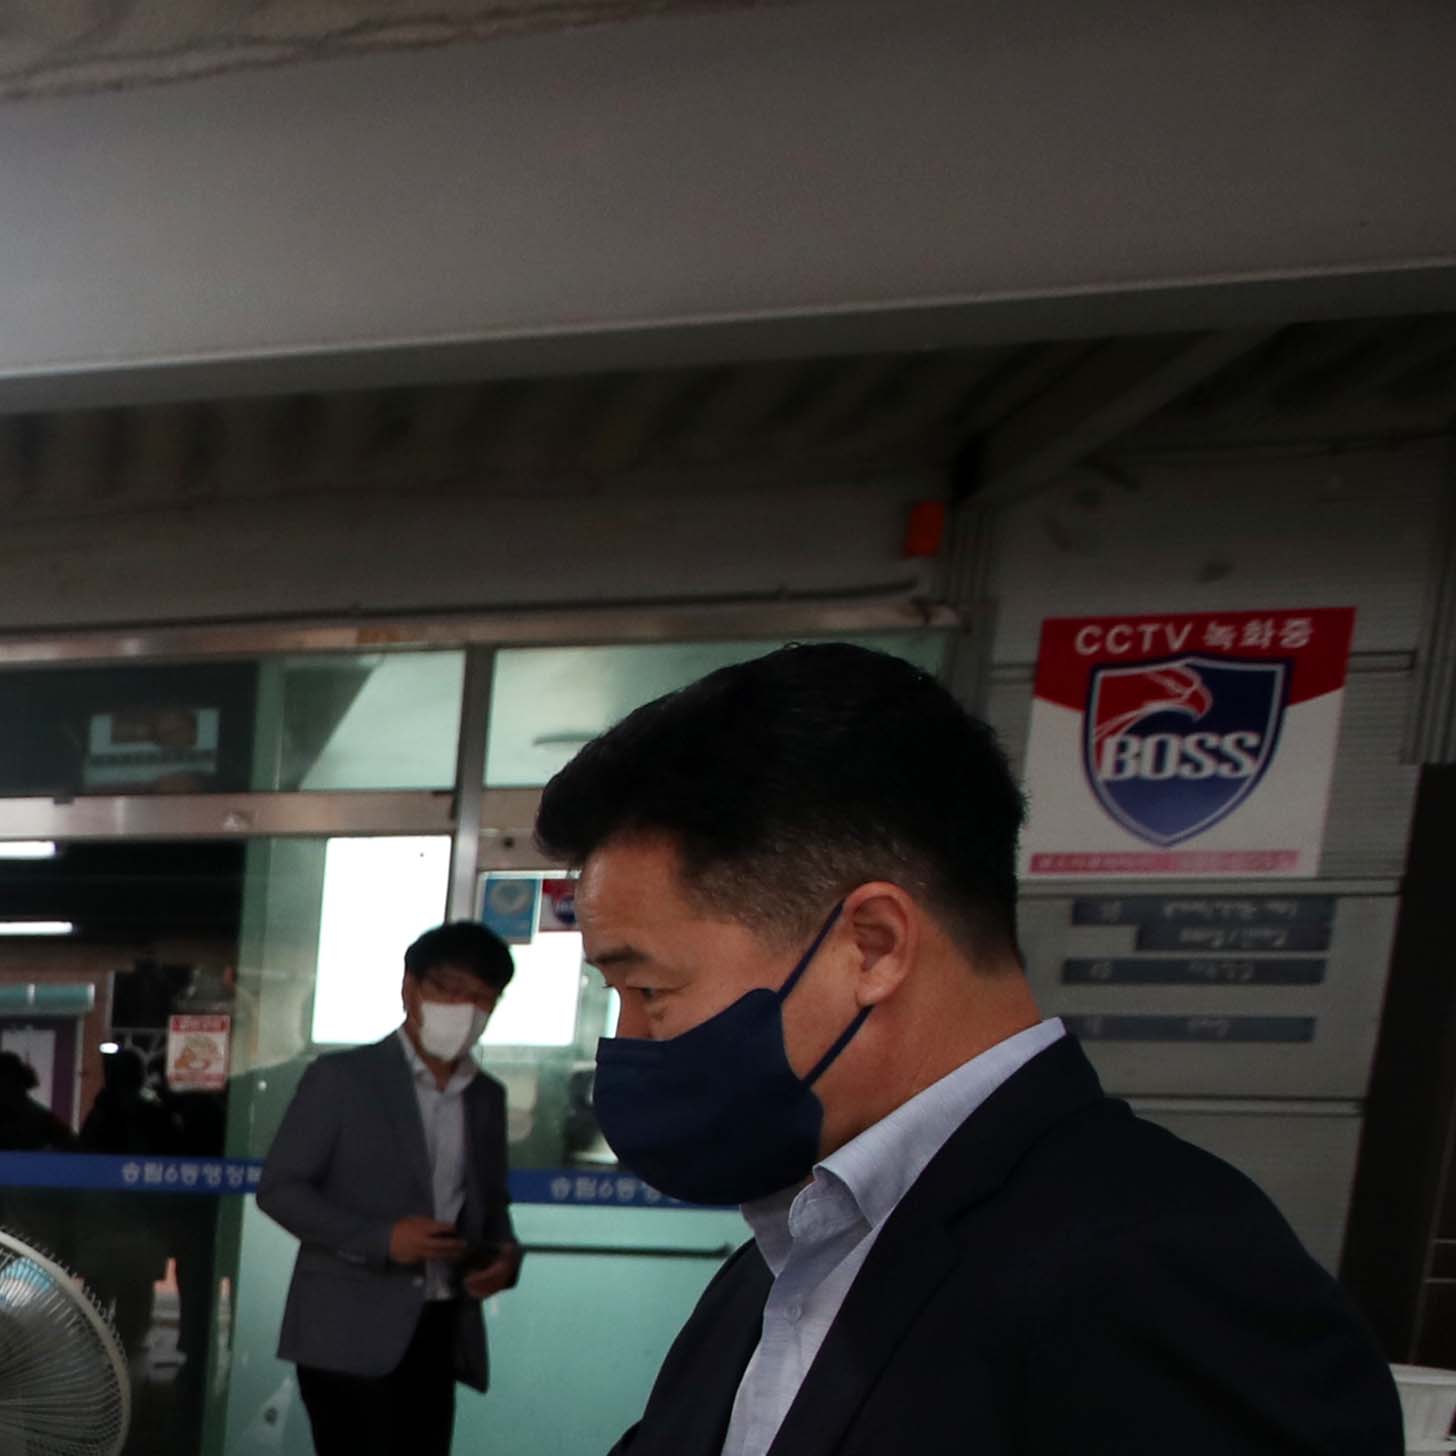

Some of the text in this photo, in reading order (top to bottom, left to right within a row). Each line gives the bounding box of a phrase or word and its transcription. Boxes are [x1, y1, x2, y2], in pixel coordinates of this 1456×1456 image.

[1075, 617, 1316, 655] CCTV 녹화중
[1096, 731, 1263, 781] BOSS
